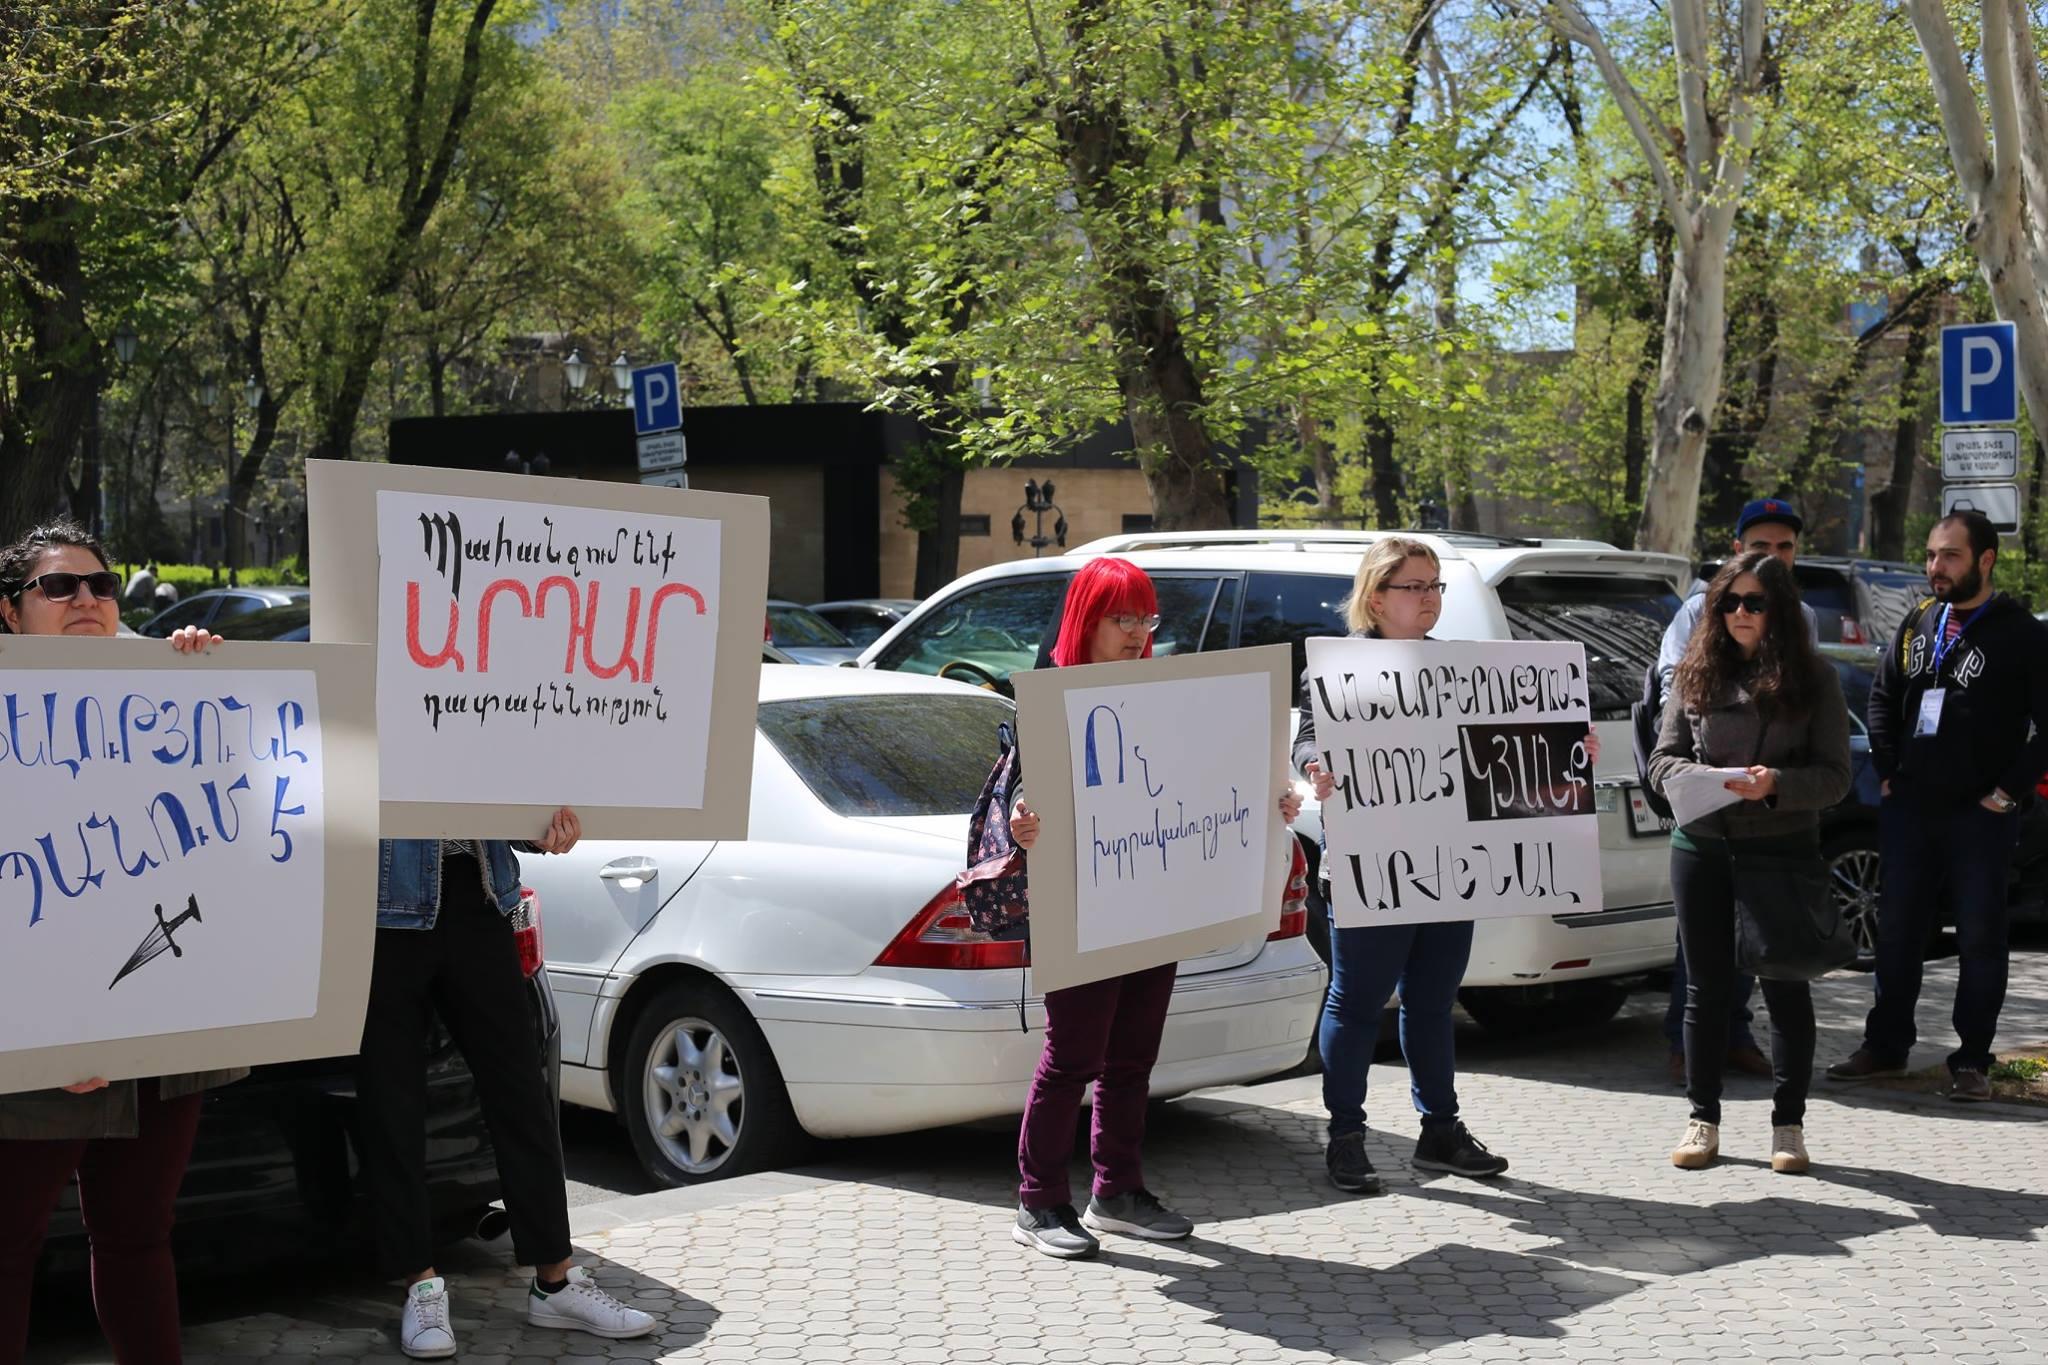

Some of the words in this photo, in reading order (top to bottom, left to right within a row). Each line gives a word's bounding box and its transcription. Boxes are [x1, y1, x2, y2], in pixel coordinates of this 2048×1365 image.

[644, 372, 670, 425] P
[1962, 335, 2003, 413] P
[633, 530, 676, 578] ենք
[406, 575, 707, 684] ԱՐԴԱՐ
[0, 691, 309, 779] ԵԼՈՒԹՅՈՒՆԸ
[423, 681, 667, 733] դատաքննություն
[1438, 744, 1459, 797] Է
[1461, 727, 1588, 818] ԿՅԱՆՔ
[270, 775, 305, 863] Է
[1345, 840, 1582, 911] ԱՐԺԵՆԱԼ
